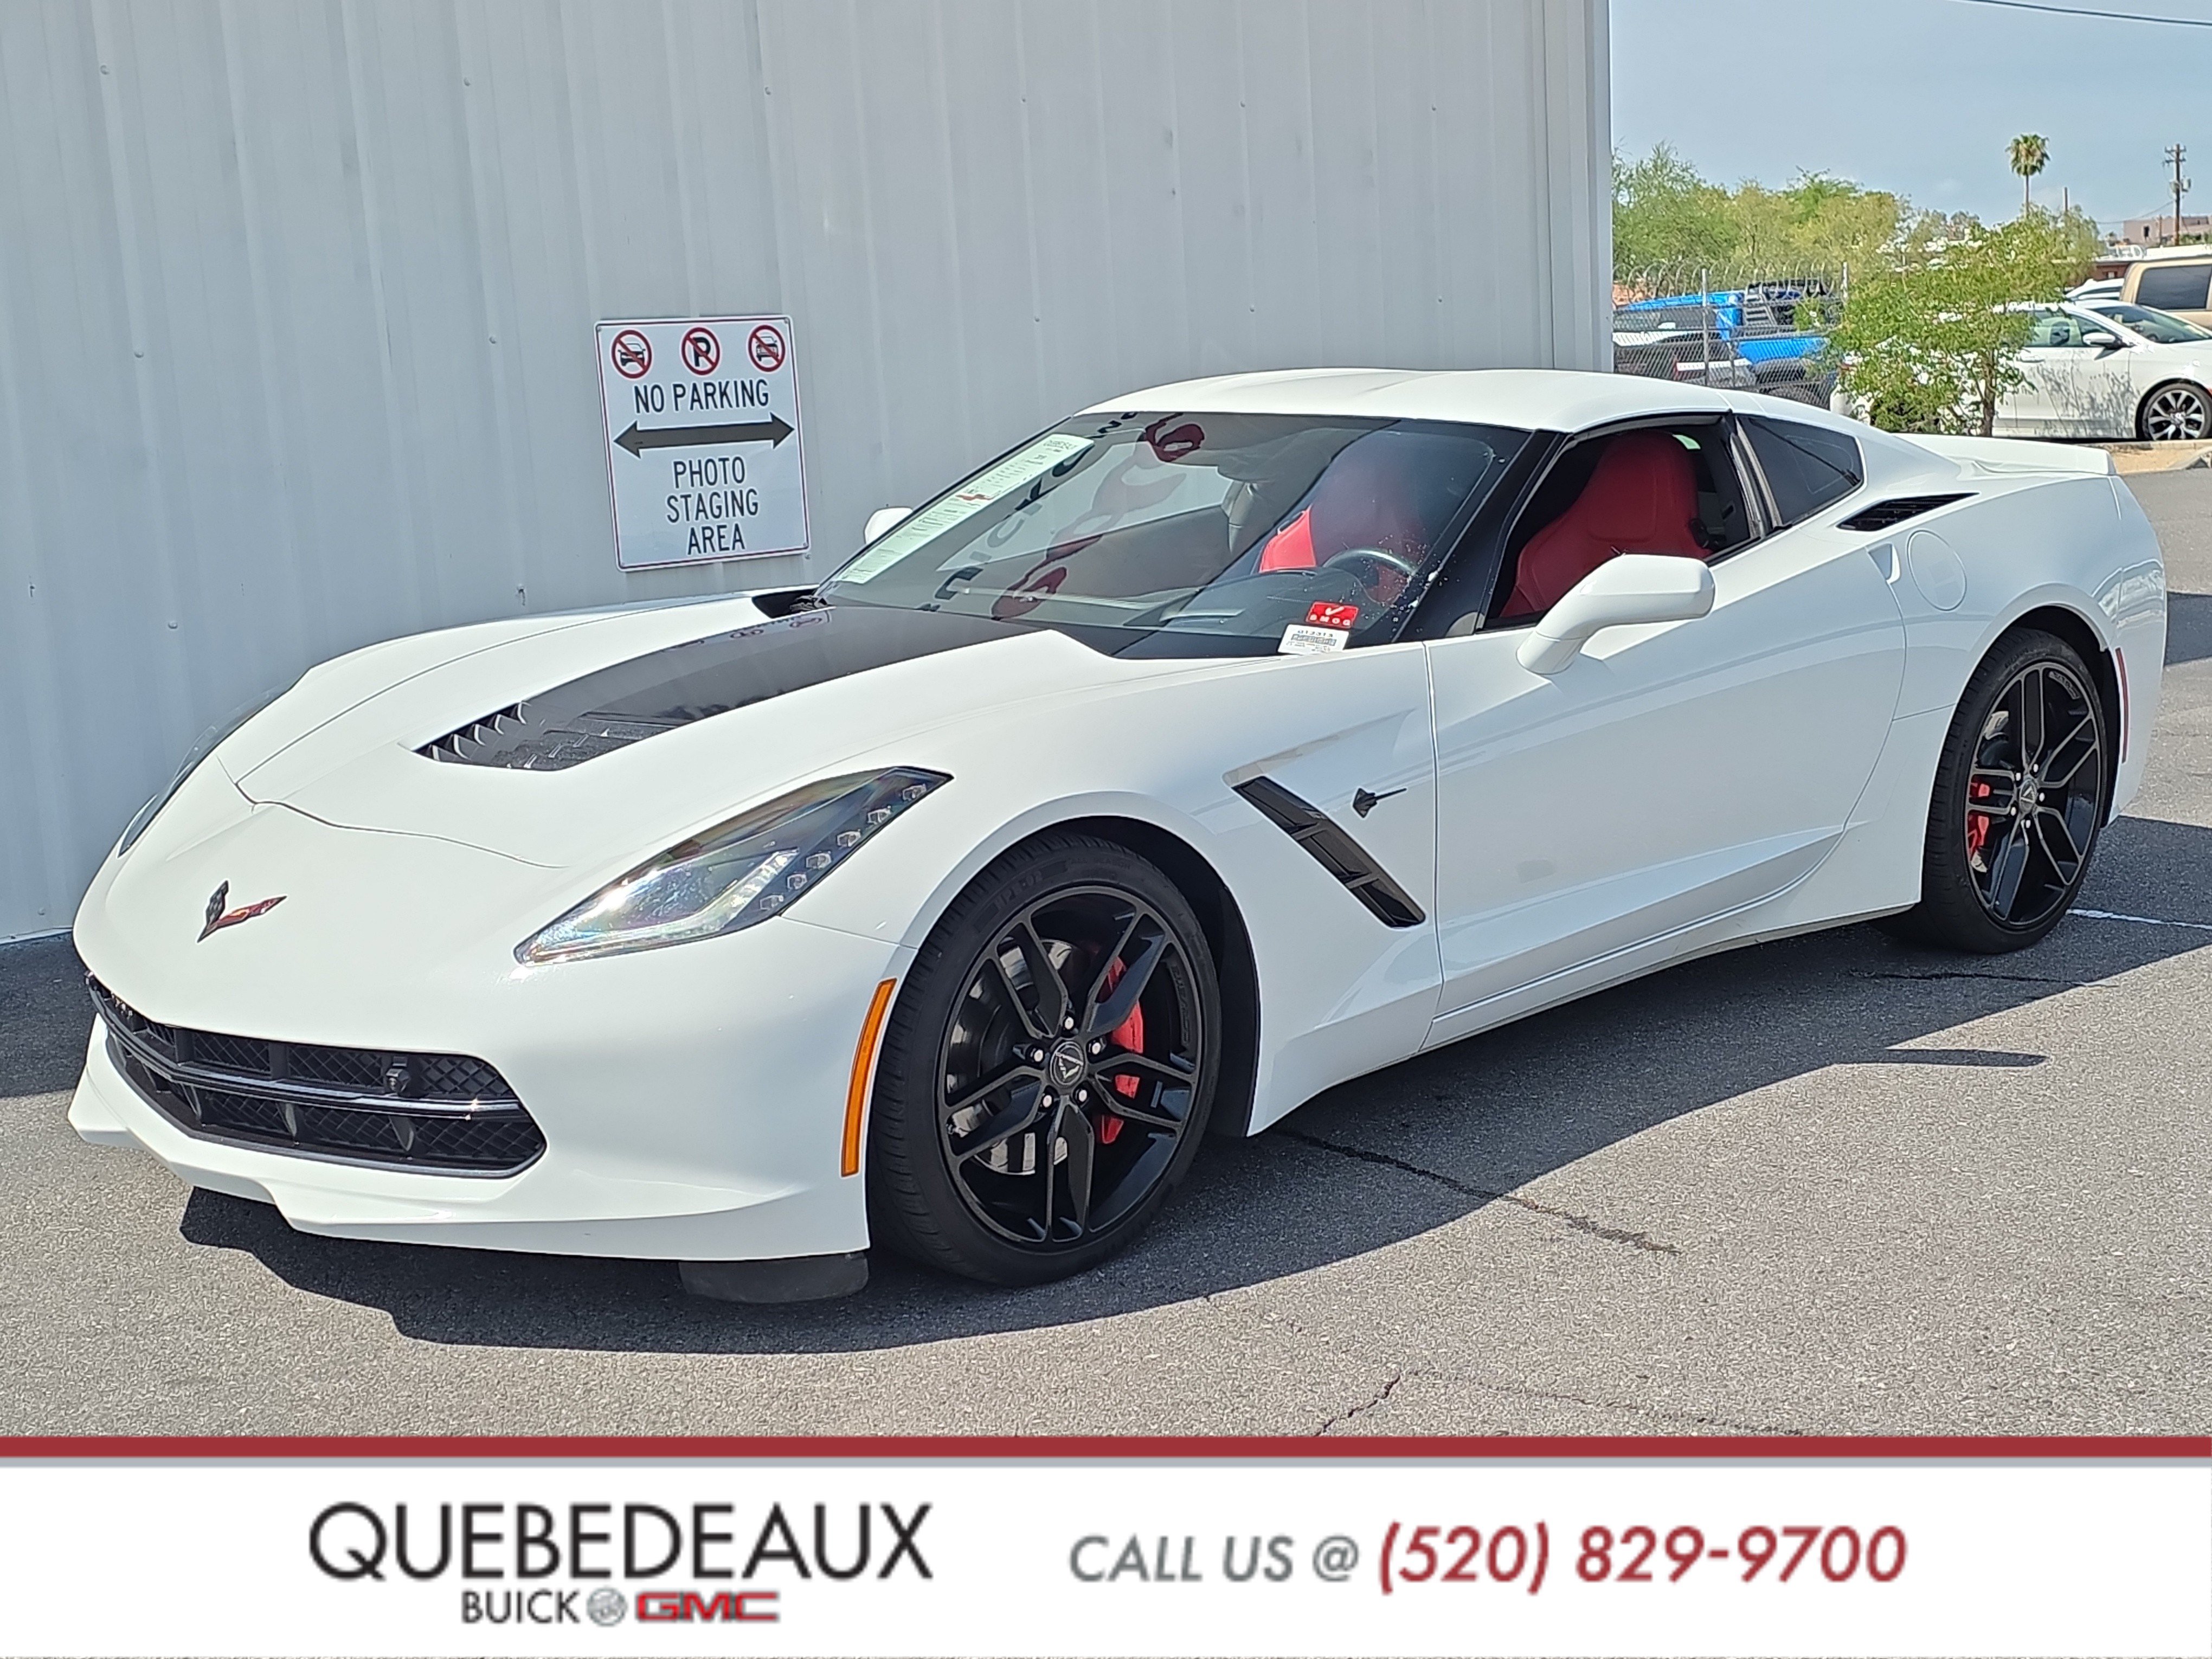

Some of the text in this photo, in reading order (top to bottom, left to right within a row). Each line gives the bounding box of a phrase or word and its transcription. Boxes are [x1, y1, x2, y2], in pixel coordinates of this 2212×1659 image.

[634, 379, 769, 413] NO PARKING
[673, 456, 745, 488] PHOTO
[667, 488, 758, 523] STAGING
[687, 523, 745, 555] AREA
